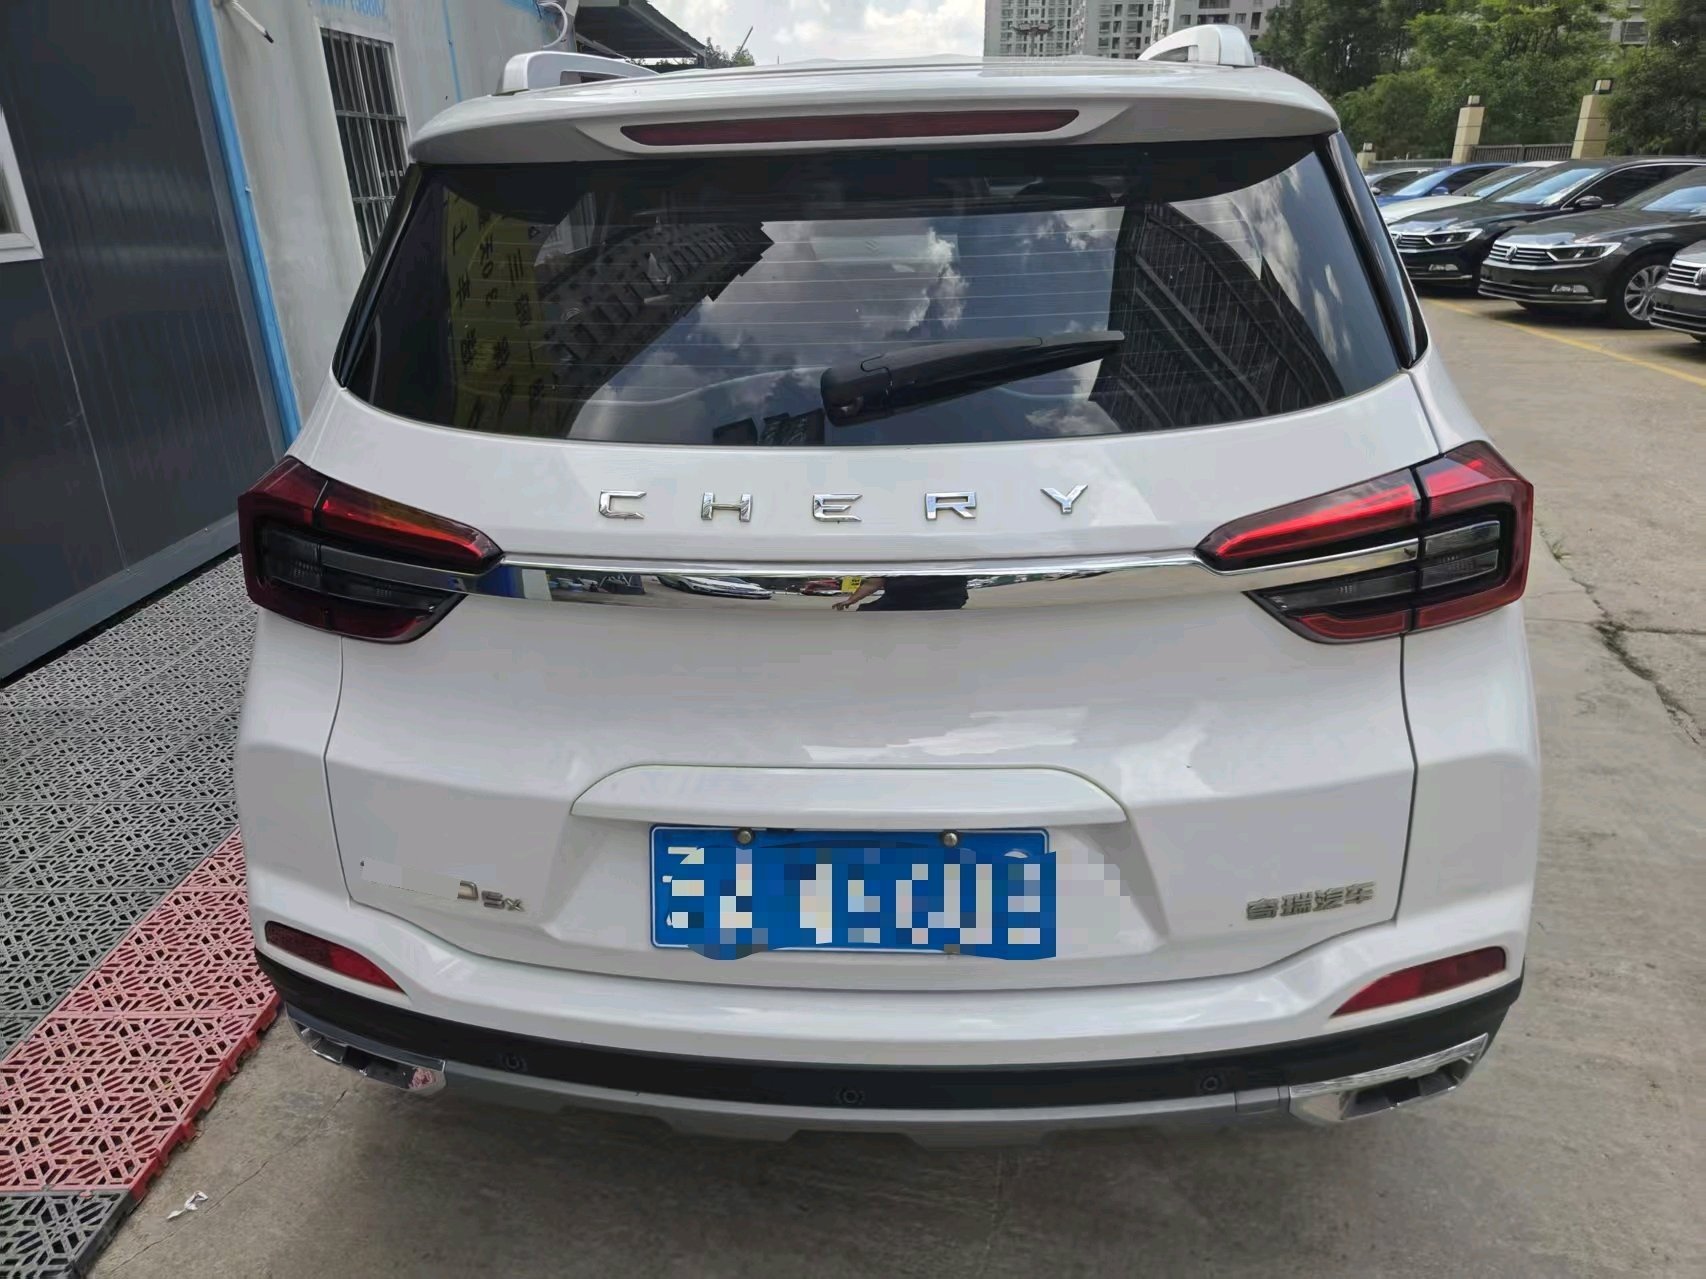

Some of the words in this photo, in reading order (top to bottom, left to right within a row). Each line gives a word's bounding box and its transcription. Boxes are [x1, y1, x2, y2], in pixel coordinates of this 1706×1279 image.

[598, 484, 1089, 523] CHERY
[1246, 881, 1376, 920] 奇瑞汽车
